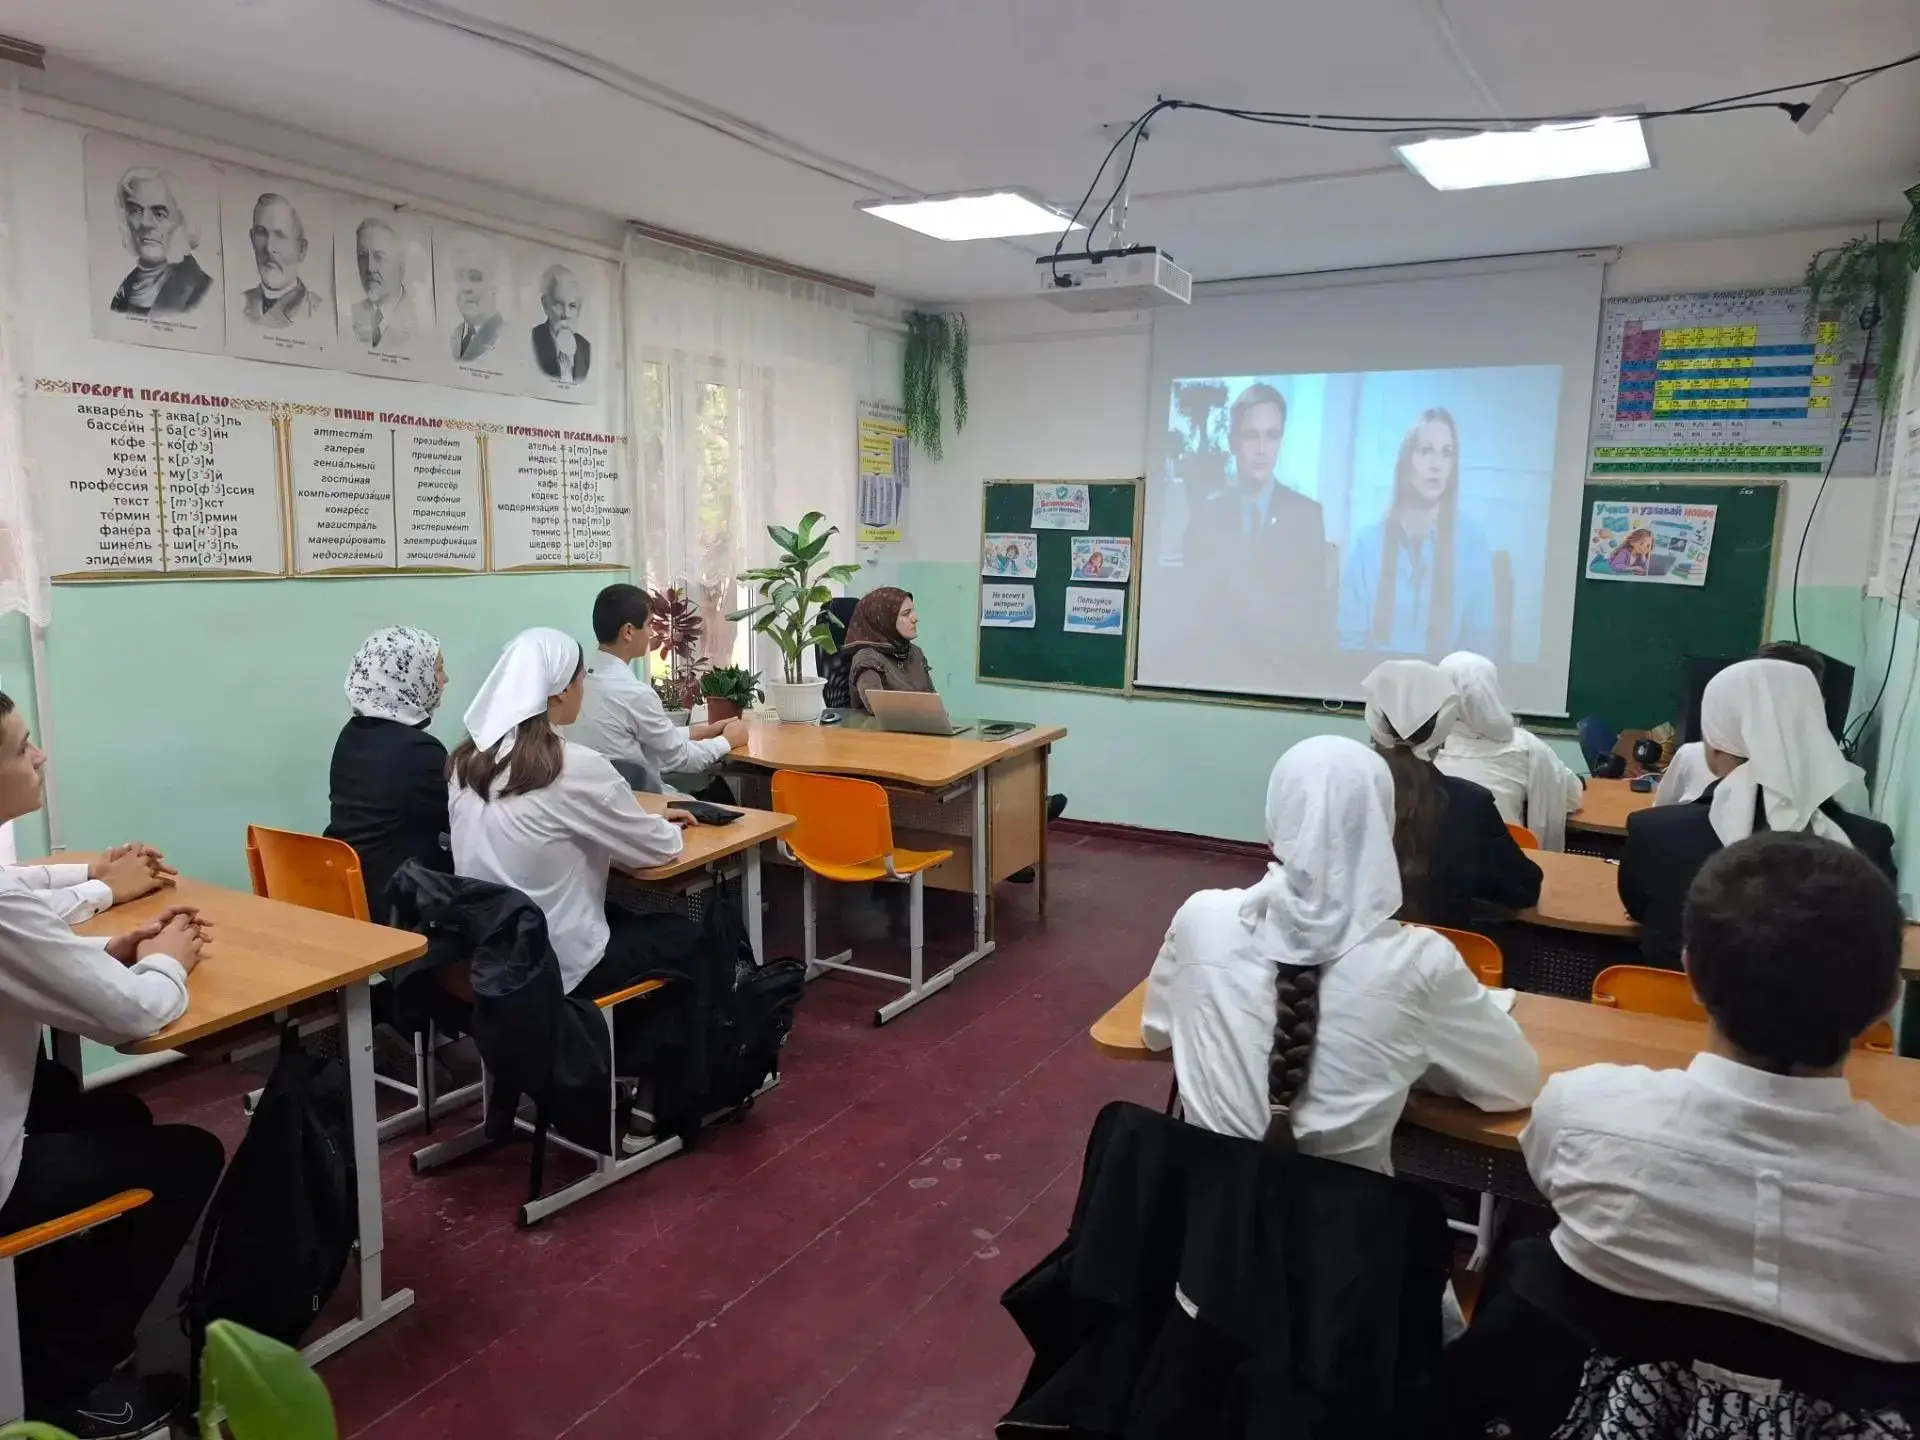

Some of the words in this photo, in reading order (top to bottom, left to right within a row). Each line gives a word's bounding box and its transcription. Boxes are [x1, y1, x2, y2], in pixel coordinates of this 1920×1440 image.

[71, 382, 134, 399] ГОВОРИ
[141, 388, 229, 408] ПРАВИЛЬНО
[334, 408, 374, 422] ПИШИ
[379, 412, 442, 428] ПРАВИЛЬНО
[507, 426, 560, 439] ПРОИЗНОСИ
[564, 432, 615, 443] ПРАВИЛЬНО
[114, 452, 146, 463] крем
[114, 497, 149, 505] текст
